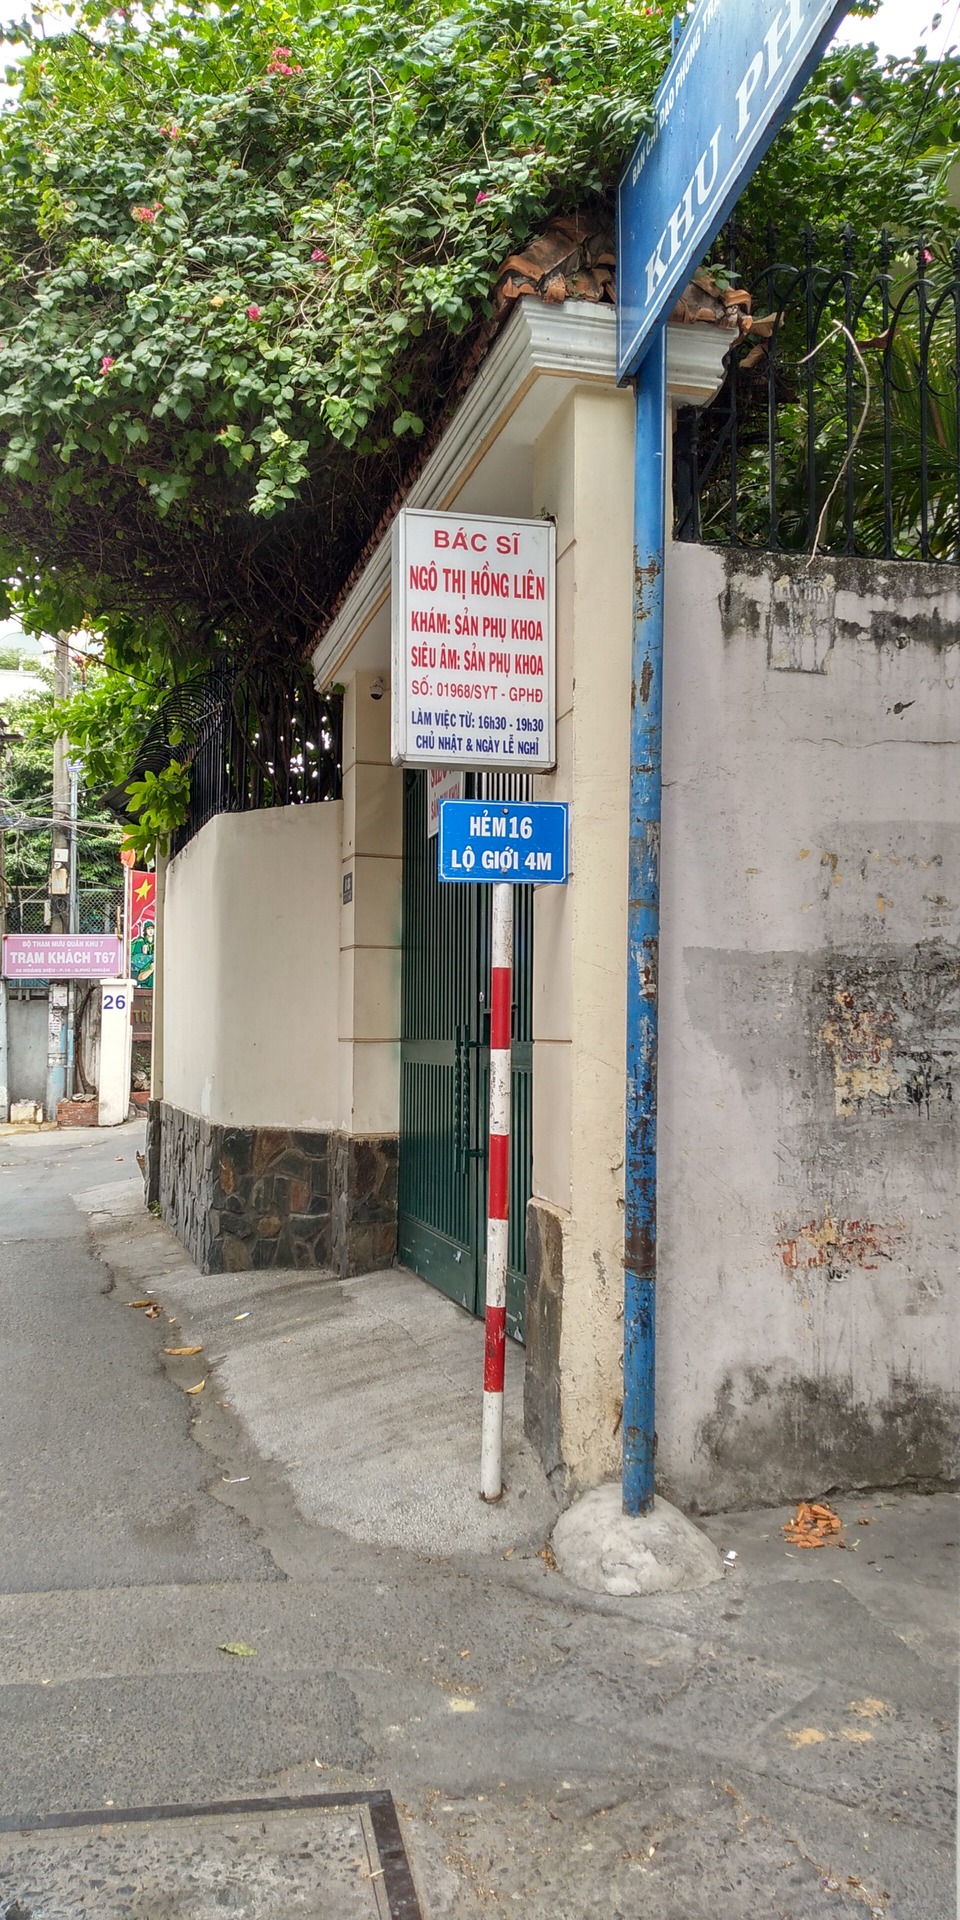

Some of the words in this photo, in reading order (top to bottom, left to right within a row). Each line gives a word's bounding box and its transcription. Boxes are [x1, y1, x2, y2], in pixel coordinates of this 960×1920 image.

[644, 124, 722, 307] KHU
[434, 527, 488, 553] BÁC
[496, 533, 520, 555] SĨ
[409, 561, 438, 592] NGÔ
[443, 568, 466, 599] THỊ
[471, 561, 509, 598] HỒNG
[513, 569, 545, 601] LIÊN
[411, 607, 451, 635] KHÁM:
[455, 607, 478, 636] SẢN
[483, 617, 507, 643] PHỤ
[511, 620, 543, 641] KHOA
[411, 642, 436, 669] SIÊU
[440, 643, 460, 670] ÂM:
[464, 643, 486, 672] SẢN
[489, 653, 511, 678] PHỤ
[515, 654, 544, 676] KHOA
[412, 677, 433, 696] SỐ:
[437, 682, 498, 700] 01968/SYT
[509, 687, 543, 703] GPHĐ
[412, 707, 433, 726] LÀM
[434, 709, 457, 729] VIỆC
[459, 712, 475, 728] TỪ:
[478, 716, 507, 730] 16h30
[516, 718, 544, 732] 19h30
[416, 731, 435, 750] CHỦ
[438, 734, 463, 753] NHẬT
[466, 738, 473, 752] &
[476, 736, 500, 753] NGÀY
[503, 734, 514, 754] LỄ
[517, 738, 539, 756] NGHỈ
[451, 846, 475, 872] LỘ
[482, 846, 519, 870] GIỚI
[524, 852, 552, 871] 4M
[22, 940, 31, 949] BỘ
[10, 951, 44, 967] TRẠM
[48, 949, 91, 964] KHÁCH
[94, 951, 116, 964] T67
[103, 995, 126, 1009] 26
